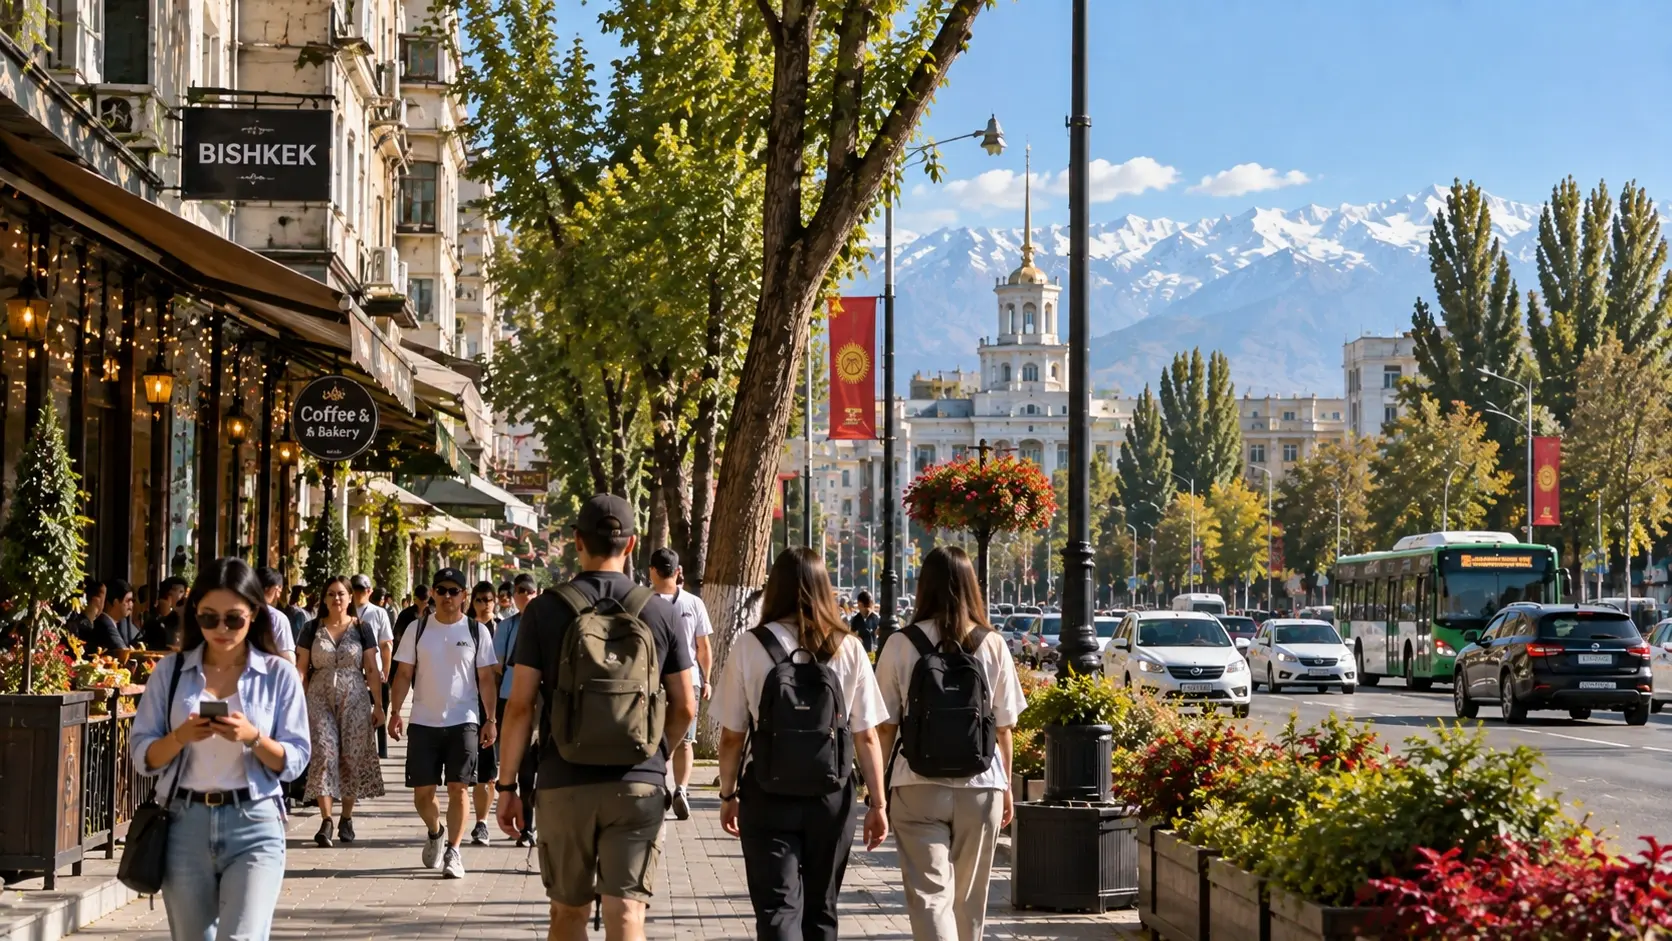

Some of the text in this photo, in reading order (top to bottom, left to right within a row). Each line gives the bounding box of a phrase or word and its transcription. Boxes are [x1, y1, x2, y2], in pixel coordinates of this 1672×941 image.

[199, 142, 317, 166] BISHKEK
[300, 405, 370, 423] Coffee &
[318, 425, 360, 441] Bakery
